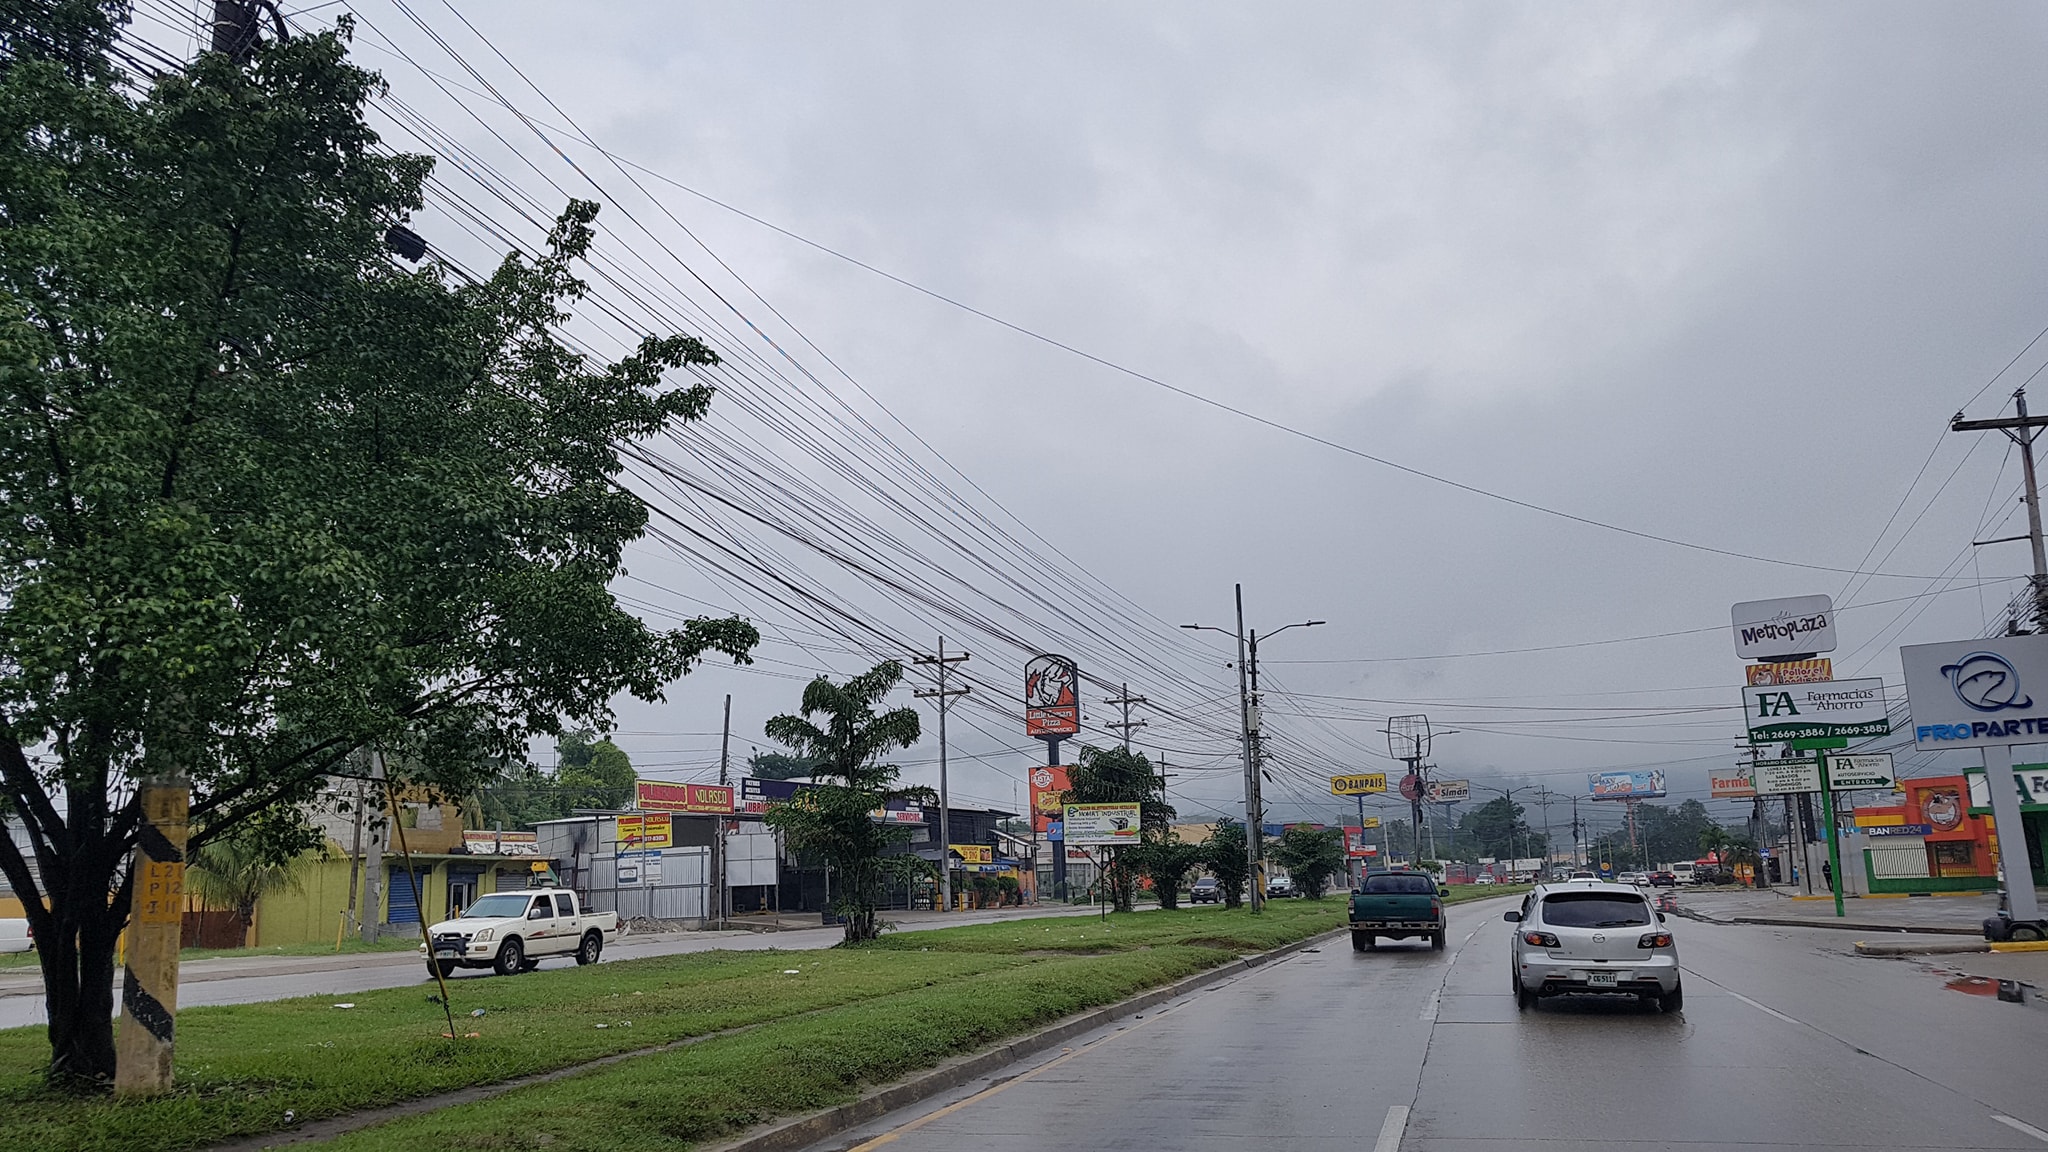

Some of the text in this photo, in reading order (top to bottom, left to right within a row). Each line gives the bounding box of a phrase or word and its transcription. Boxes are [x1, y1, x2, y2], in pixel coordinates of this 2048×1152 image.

[1783, 668, 1811, 676] Pollos
[1807, 689, 1874, 701] Farmacias
[1756, 691, 1801, 717] FA
[1817, 700, 1864, 711] Ahorro
[1029, 711, 1046, 719] Little
[1751, 731, 1770, 740] Tel:
[1771, 728, 1825, 739] 2669-3886
[1834, 725, 1888, 736] 2669-3887
[1835, 758, 1855, 769] FA
[1348, 778, 1383, 789] BANPAIS
[695, 789, 728, 804] NOLASCO
[1869, 825, 1921, 836] BANRED24
[151, 865, 160, 878] L
[150, 881, 180, 896] P 12
